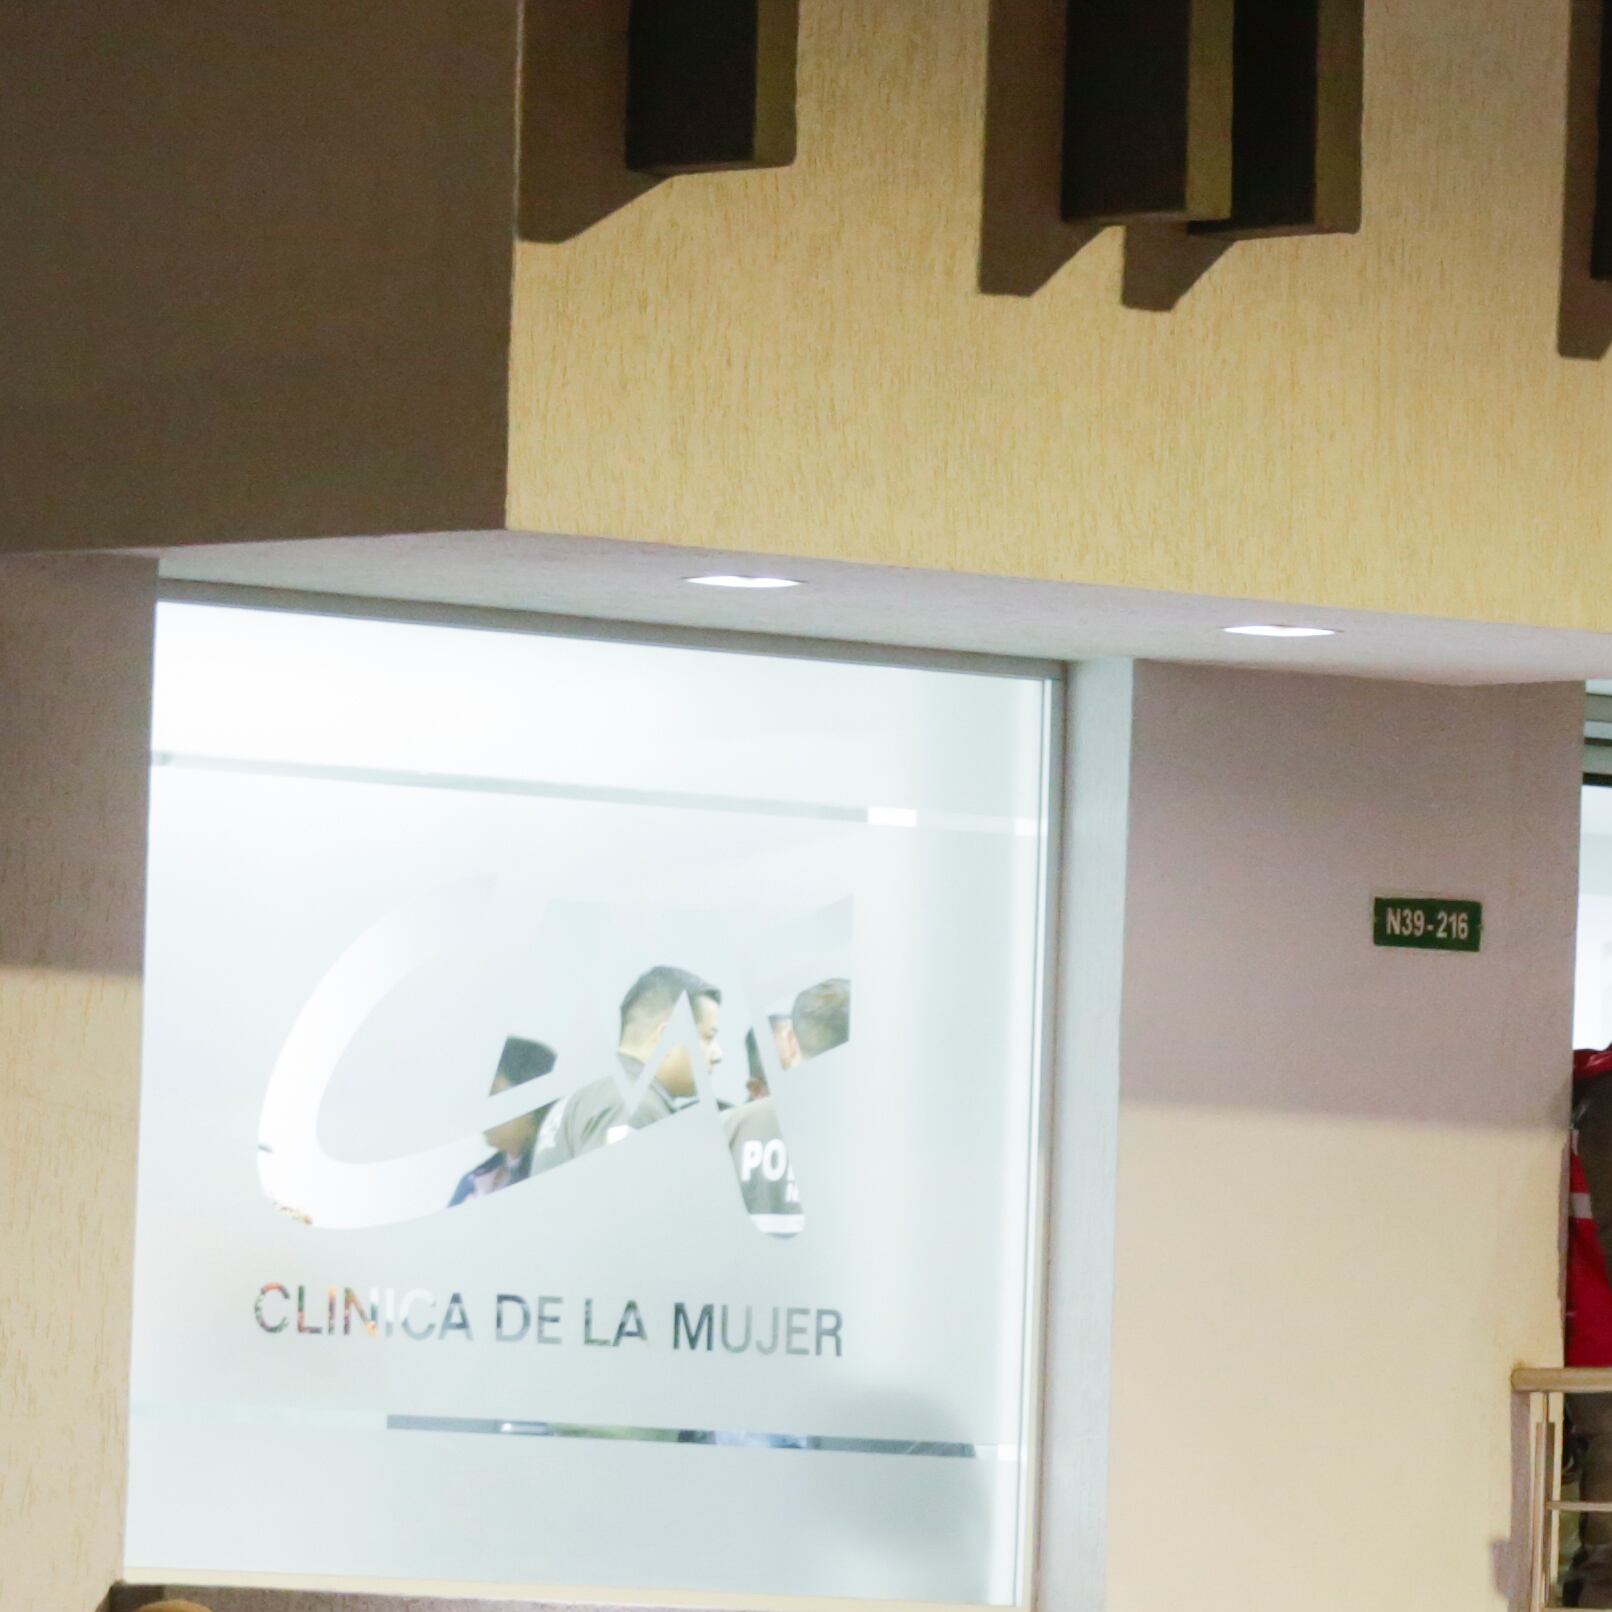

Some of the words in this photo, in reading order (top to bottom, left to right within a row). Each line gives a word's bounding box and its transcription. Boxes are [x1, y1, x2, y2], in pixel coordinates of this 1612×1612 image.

[1385, 907, 1469, 939] N39-216
[254, 1282, 474, 1343] CLINICA
[494, 1292, 564, 1345] DE
[583, 1297, 649, 1348] LA
[671, 1301, 844, 1358] MUJER
